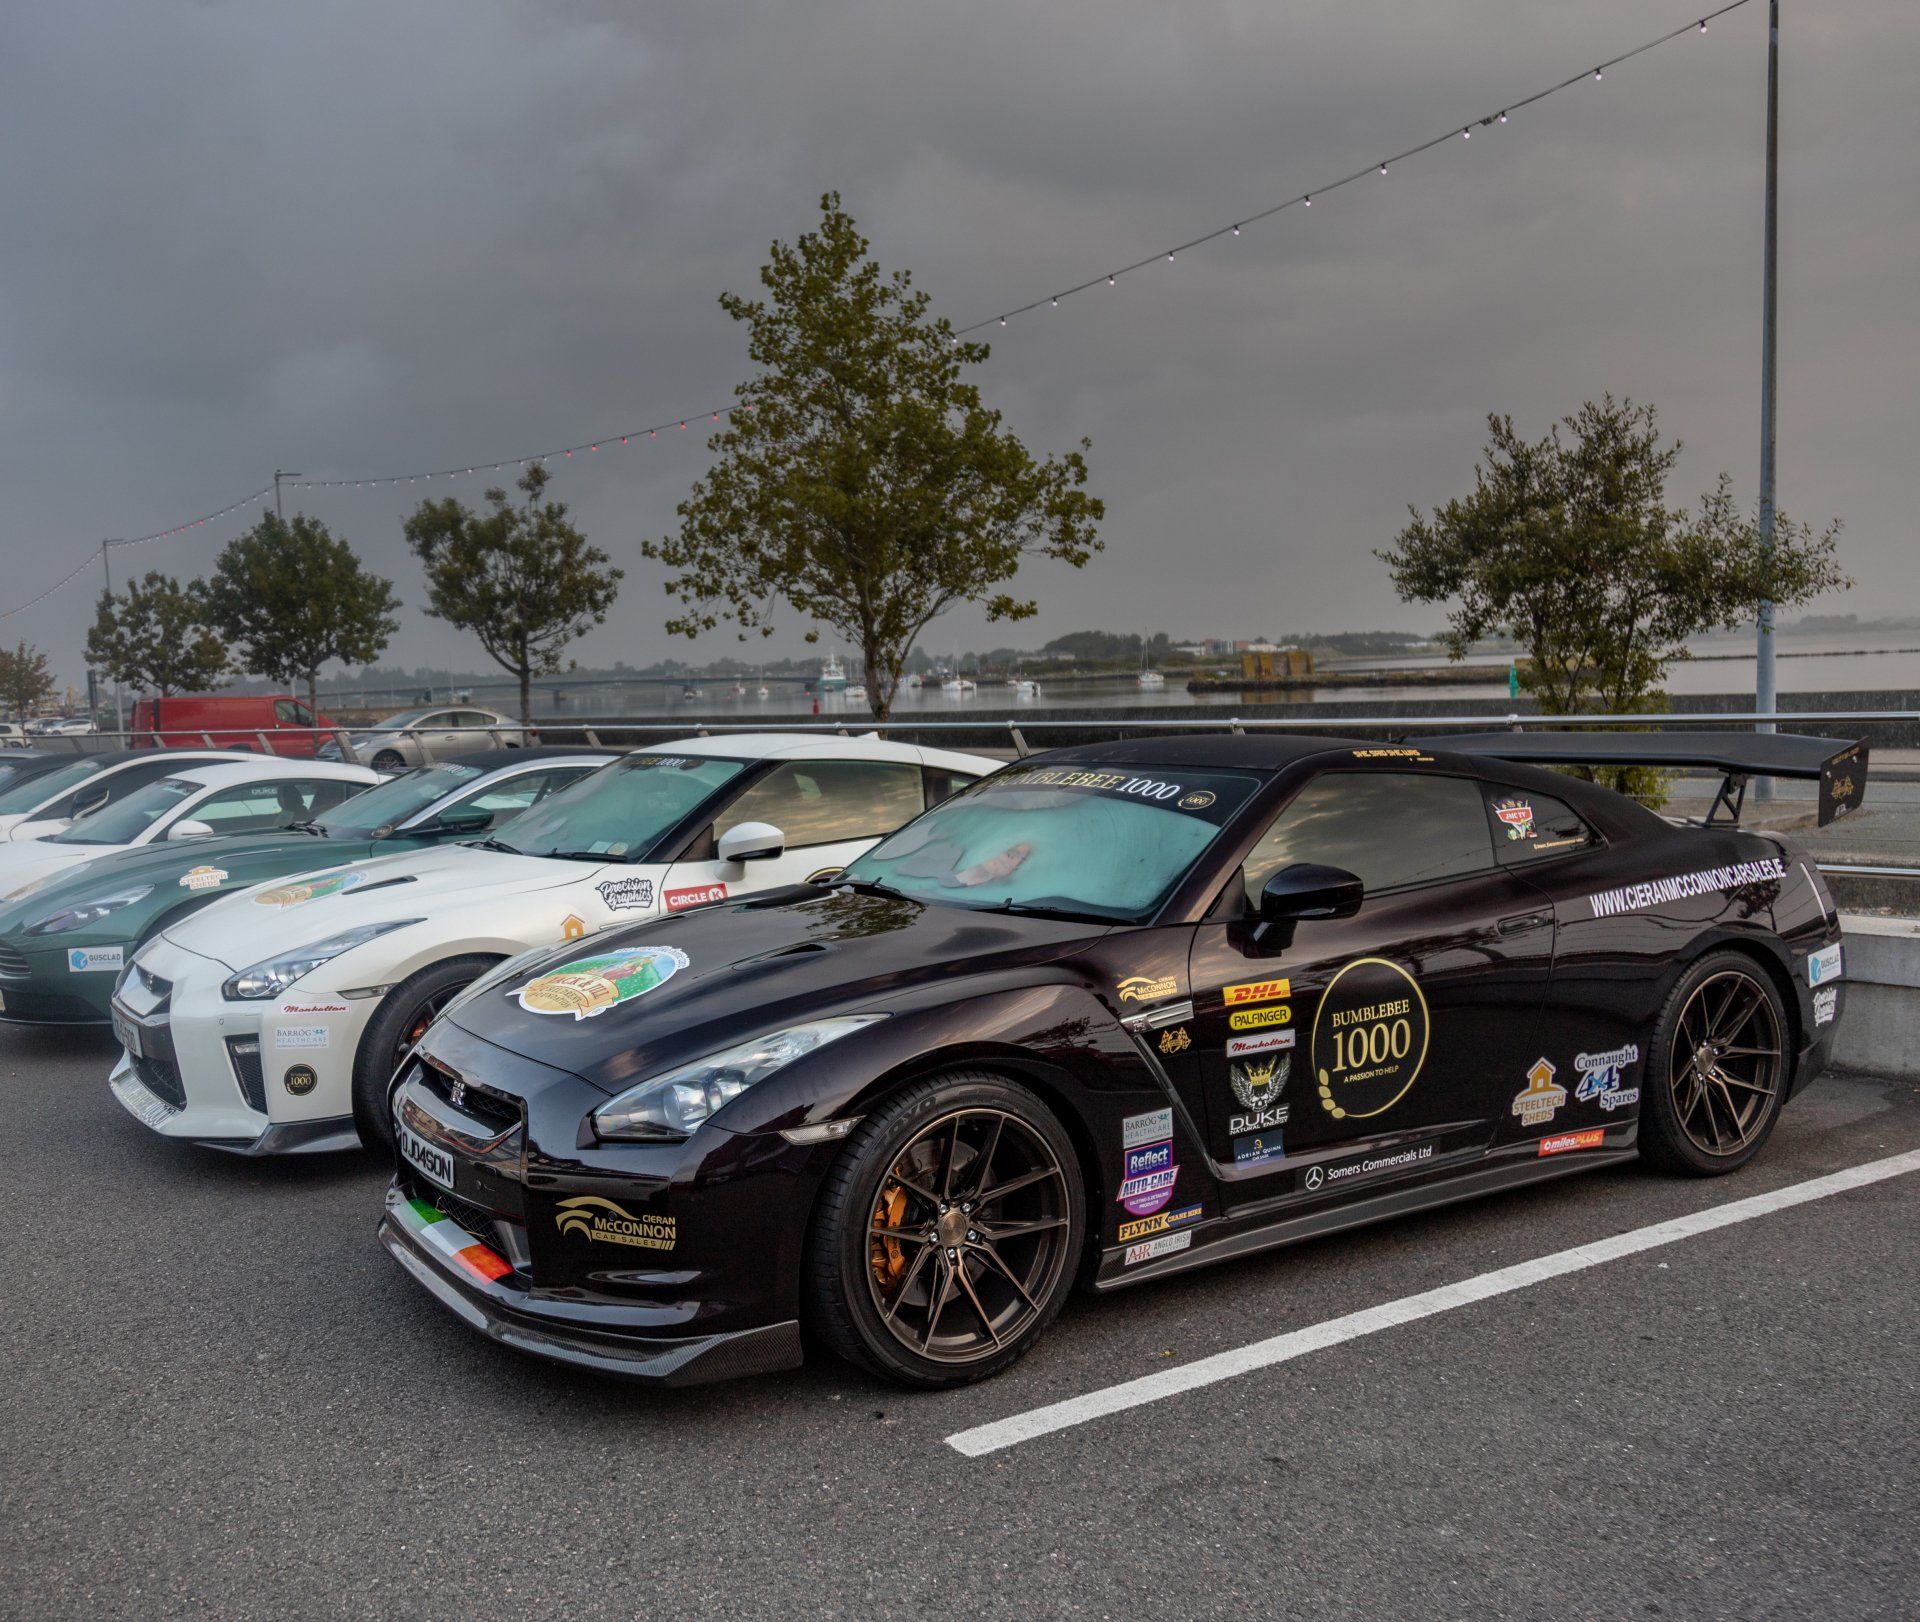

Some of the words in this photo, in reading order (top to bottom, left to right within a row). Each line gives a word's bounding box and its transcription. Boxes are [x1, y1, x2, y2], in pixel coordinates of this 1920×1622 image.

[1116, 777, 1181, 800] 1000
[599, 878, 652, 896] Precision
[1590, 858, 1786, 918] WWW.CIERANMCCONNONCARSALES.IE
[609, 890, 652, 911] Graphics
[669, 893, 707, 906] CIRCLE
[711, 890, 721, 900] K
[1233, 984, 1282, 1002] DHL
[284, 1005, 347, 1013] Manhattan
[1234, 1009, 1287, 1027] PALFINGER
[1332, 999, 1410, 1028] BUMBLEBEE
[1232, 1039, 1290, 1053] Manhattan
[1332, 1019, 1411, 1073] 1000
[1576, 1048, 1637, 1069] Connaught
[290, 1077, 311, 1085] 1000
[1350, 1070, 1374, 1082] PASSION
[1375, 1068, 1384, 1077] TO
[1384, 1065, 1399, 1075] HELP
[1513, 1094, 1564, 1113] STEELTECH
[1601, 1091, 1637, 1108] Spares
[1230, 1107, 1288, 1131] DUKE
[1230, 1124, 1261, 1135] NATURAL
[1262, 1117, 1288, 1128] ENERGY
[1523, 1110, 1553, 1124] SHEDS
[1130, 1148, 1168, 1169] Reflect
[1237, 1150, 1260, 1160] ADRIAN
[1328, 1163, 1361, 1180] Somers
[1362, 1150, 1417, 1173] Commercials
[1418, 1145, 1432, 1159] Ltd
[1123, 1171, 1175, 1194] AUTO-CARE
[595, 1217, 676, 1239] McCONNON
[642, 1214, 676, 1225] CIERAN
[1120, 1218, 1163, 1239] FLYNN
[595, 1232, 616, 1240] CAR
[621, 1236, 657, 1247] SALES
[1153, 1237, 1173, 1251] ANGLO
[1174, 1231, 1191, 1245] IRISH
